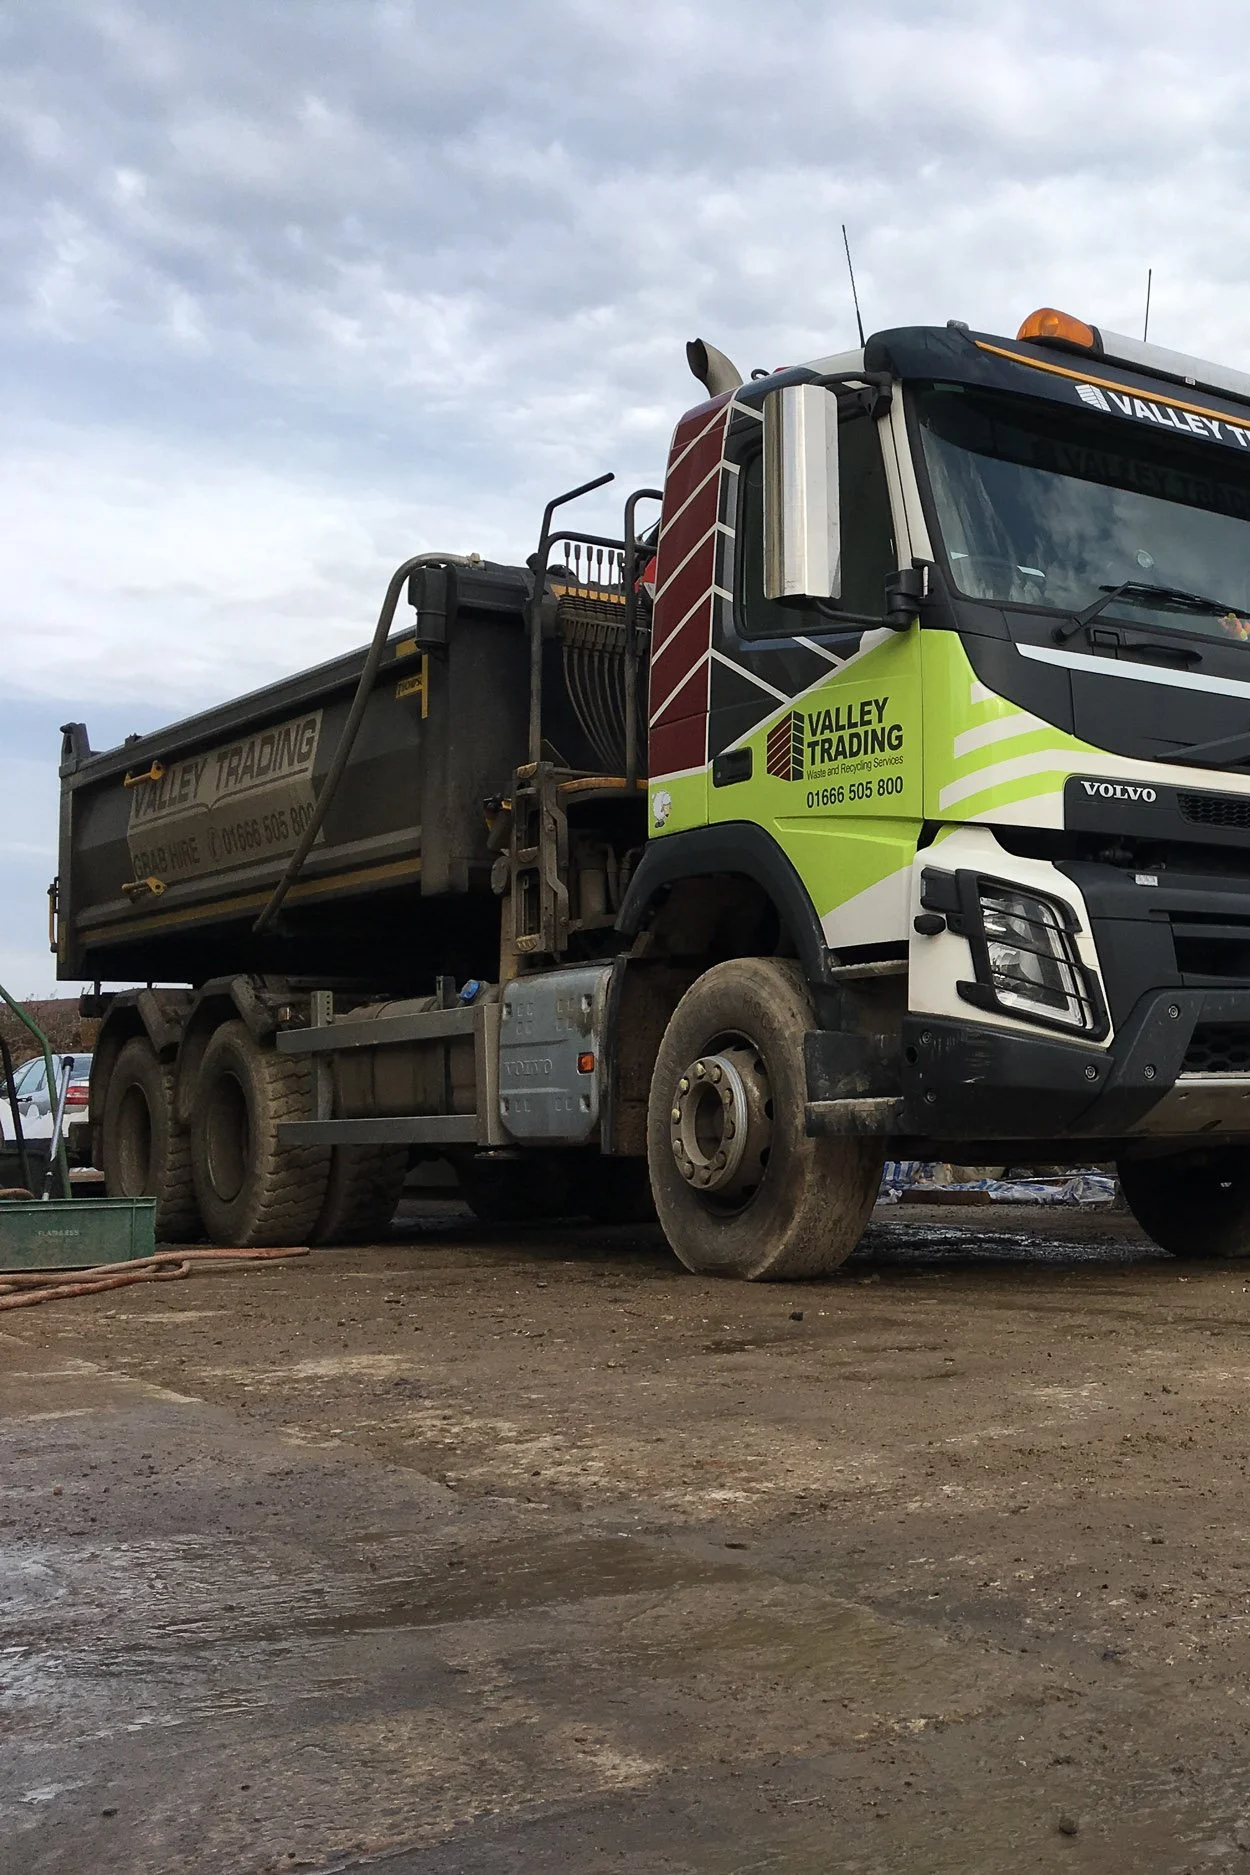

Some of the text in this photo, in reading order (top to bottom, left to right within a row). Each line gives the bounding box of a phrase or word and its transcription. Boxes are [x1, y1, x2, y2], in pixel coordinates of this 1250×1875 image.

[1107, 390, 1226, 440] VALLEY
[807, 697, 890, 737] VALLEY
[807, 724, 903, 766] TRADING
[133, 719, 317, 818] VALLEY TRADING
[807, 754, 904, 781] Waste and Recycling Services
[806, 776, 904, 808] 01666 505 800
[1080, 780, 1157, 803] VOLVO
[134, 844, 169, 878] GRAB
[169, 837, 200, 870] HIRE
[222, 819, 261, 854] 01666
[262, 810, 289, 845] 505
